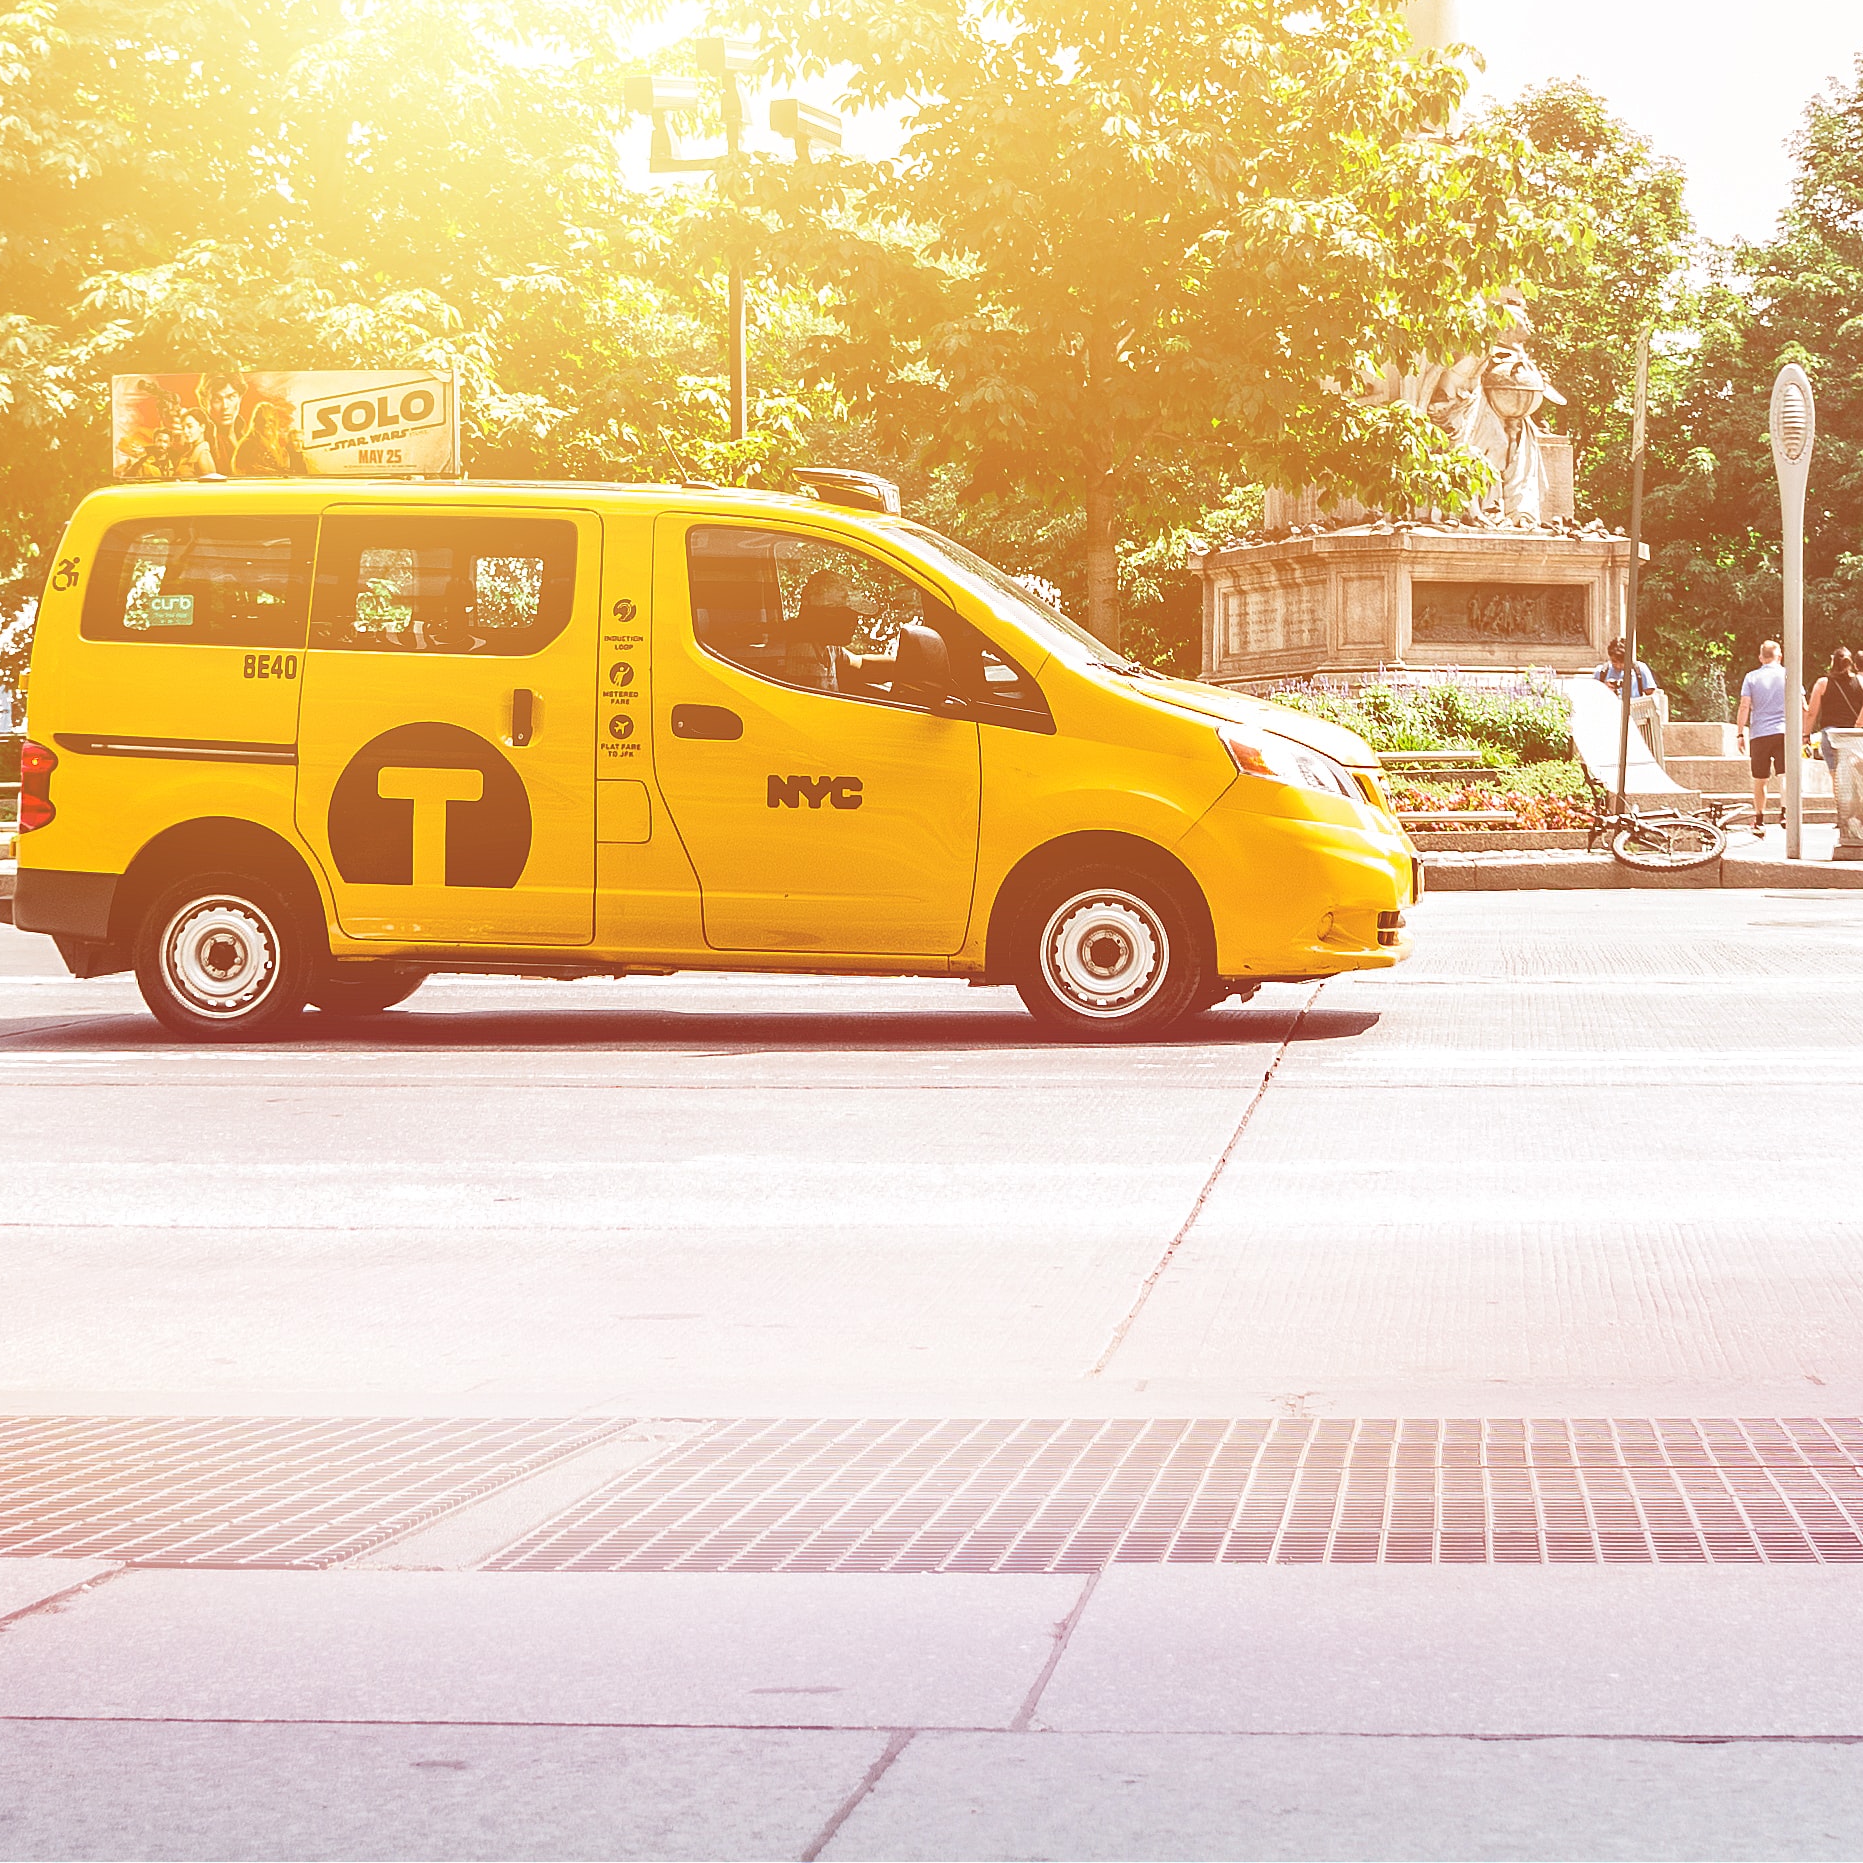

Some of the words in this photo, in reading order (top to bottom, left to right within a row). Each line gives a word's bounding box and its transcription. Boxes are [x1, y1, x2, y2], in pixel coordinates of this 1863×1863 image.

[312, 389, 435, 440] SOLO
[329, 436, 369, 452] STAR
[369, 428, 411, 444] WARS
[358, 449, 383, 464] MAY
[386, 449, 402, 464] 25
[151, 595, 192, 611] curb
[243, 654, 297, 679] 8E40
[602, 690, 639, 698] METERED
[600, 742, 620, 750] FLAT
[620, 743, 641, 751] FARE
[608, 750, 618, 758] TO
[620, 750, 634, 758] JFK
[766, 774, 864, 810] NYC
[377, 766, 484, 887] T
